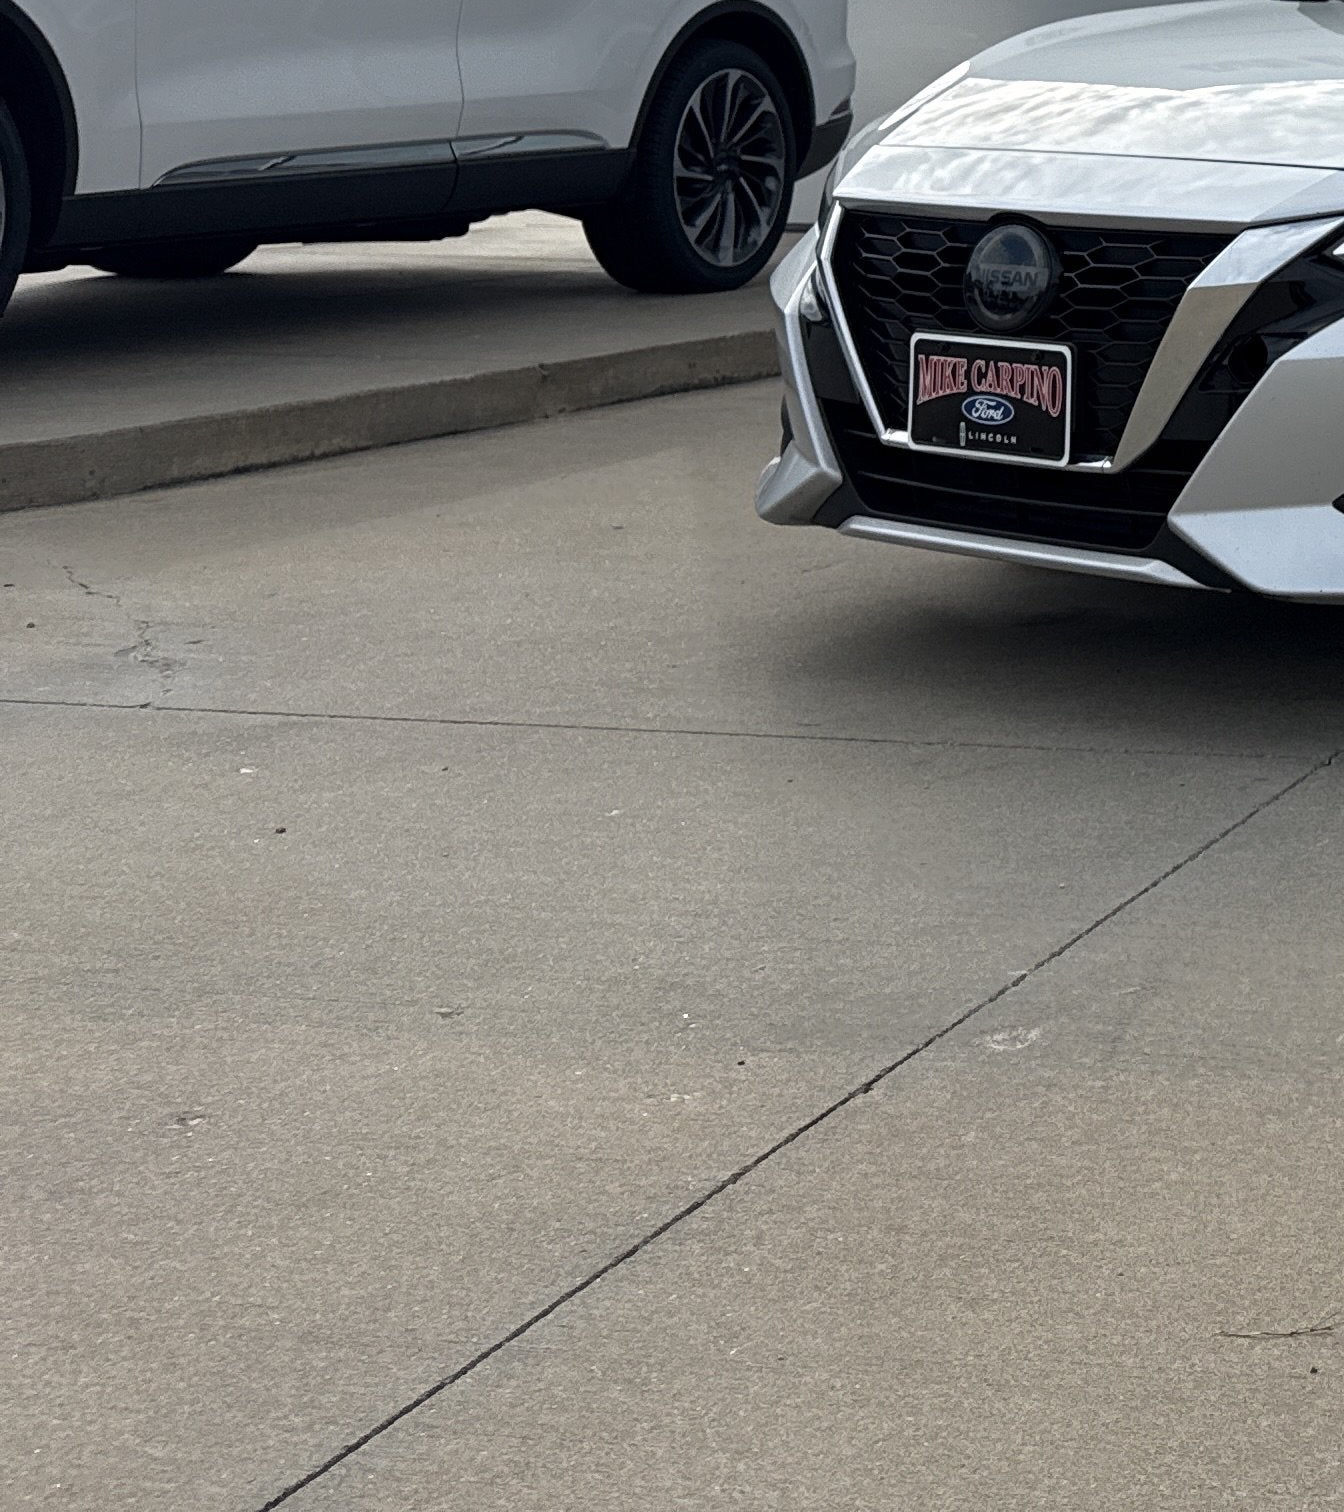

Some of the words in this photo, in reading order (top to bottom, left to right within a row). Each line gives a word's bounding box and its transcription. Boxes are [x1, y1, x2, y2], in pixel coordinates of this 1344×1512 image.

[916, 354, 968, 405] MIKE
[970, 358, 1063, 418] CARPINO
[971, 399, 1005, 419] Ford
[968, 431, 1017, 444] LINCOLN
